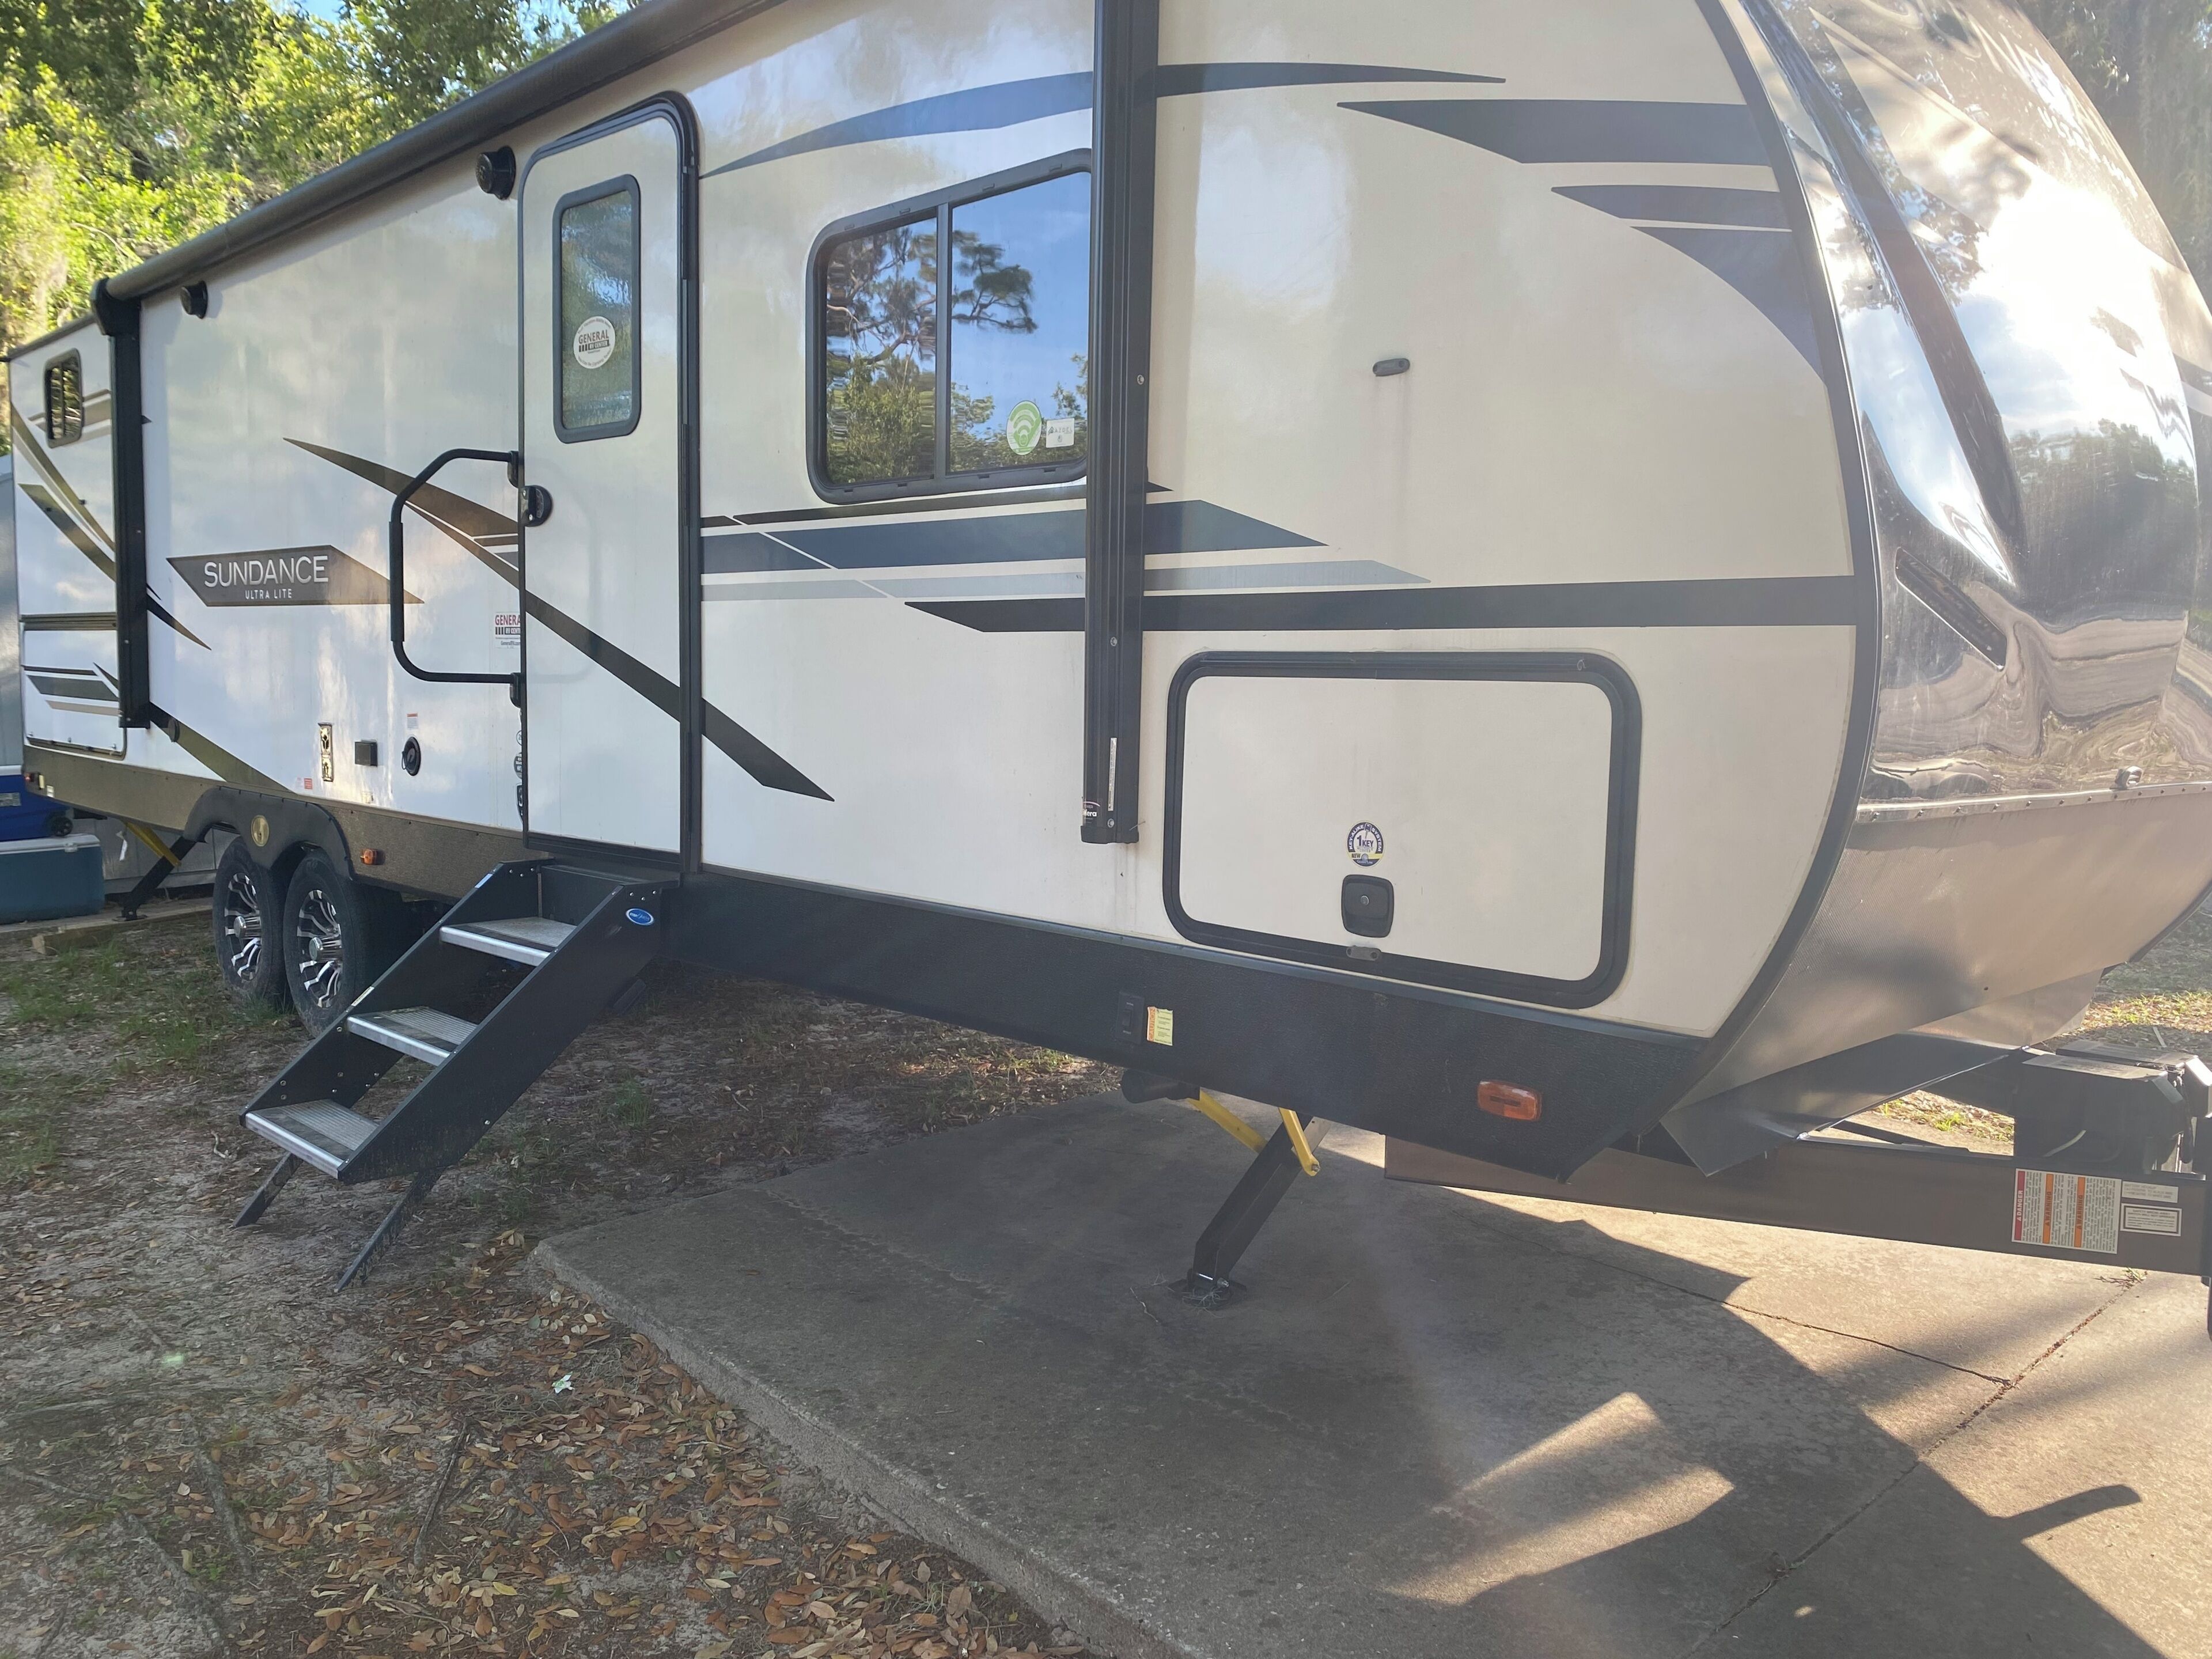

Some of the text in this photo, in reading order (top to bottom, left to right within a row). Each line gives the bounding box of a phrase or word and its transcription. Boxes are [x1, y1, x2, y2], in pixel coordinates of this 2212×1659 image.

[578, 329, 609, 344] GENERAL
[204, 555, 328, 588] SUNDANCE
[245, 589, 292, 600] ULTRA LITE
[495, 615, 521, 626] GENERA
[1349, 824, 1382, 852] KEY-ALIKE SYSTEM
